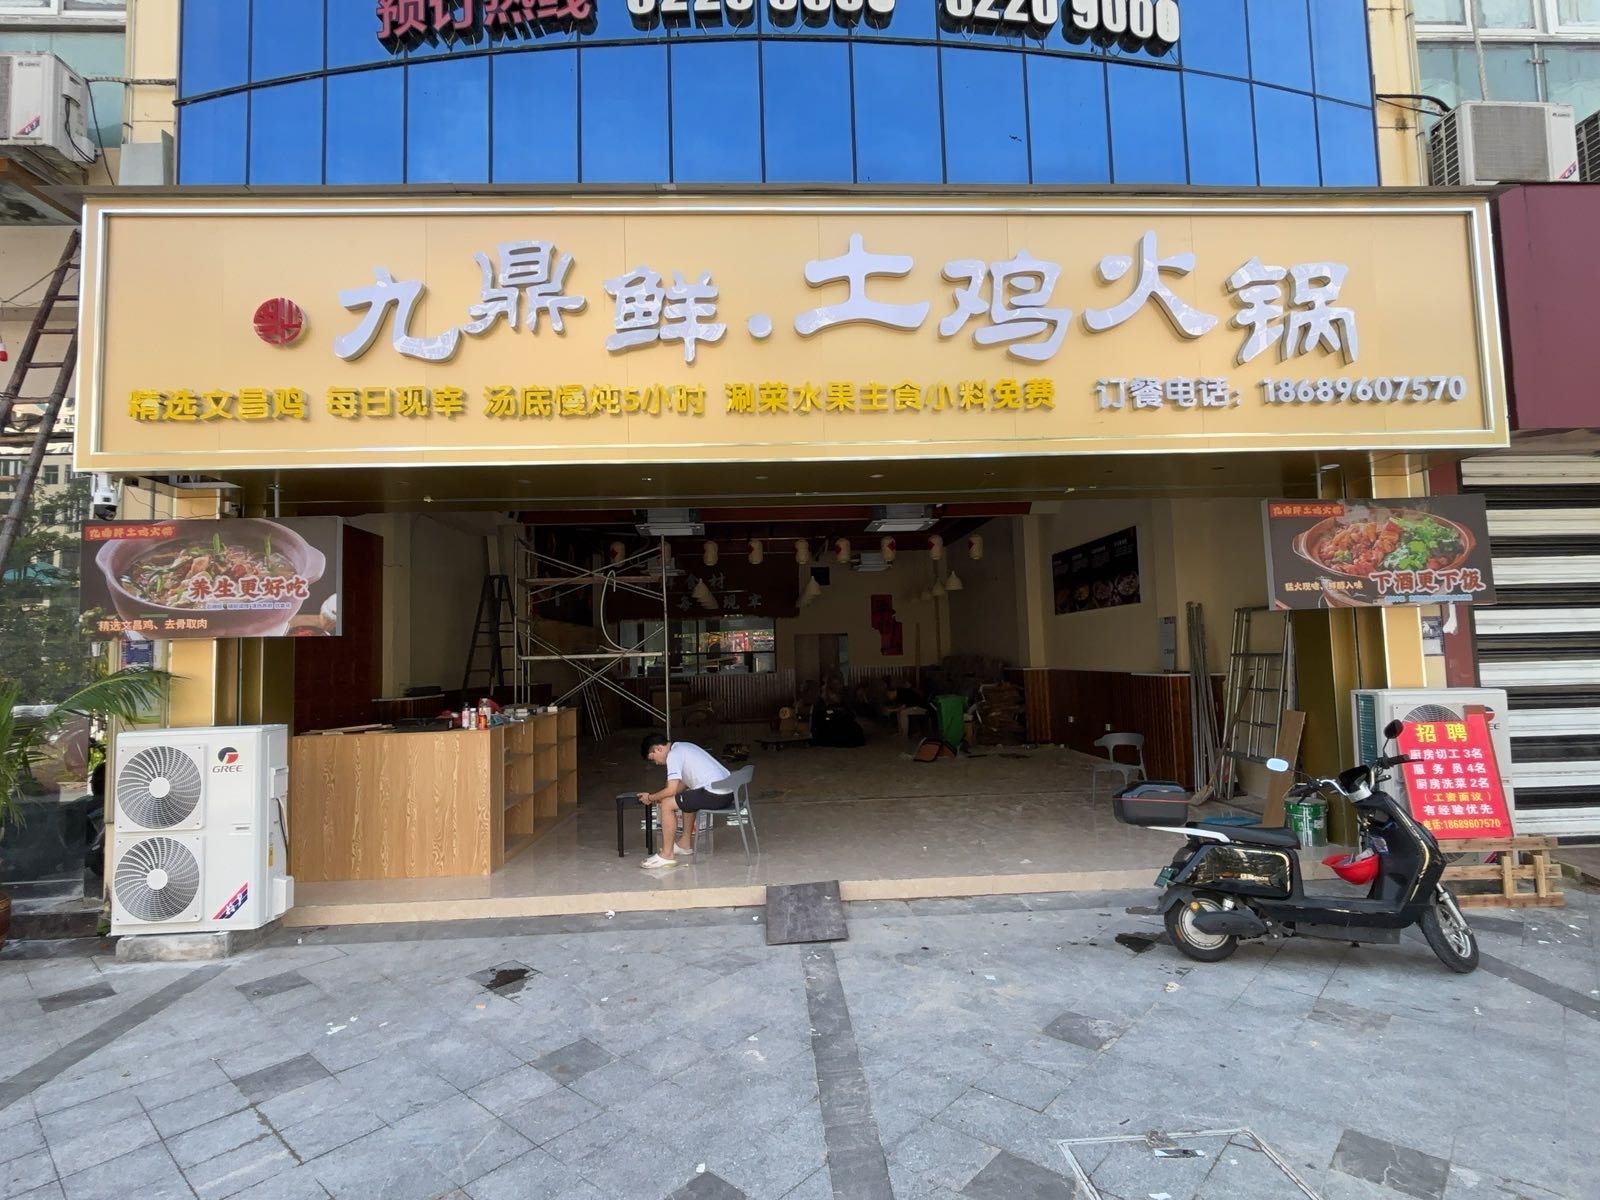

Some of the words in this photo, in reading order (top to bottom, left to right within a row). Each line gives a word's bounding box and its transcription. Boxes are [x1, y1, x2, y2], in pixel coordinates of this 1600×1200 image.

[128, 386, 306, 421] 精选文昌鸡
[326, 384, 466, 418] 每日现宰
[482, 383, 706, 418] 汤底慢炖5小时
[724, 378, 1057, 414] 涮菜水果主食小料免费
[1262, 374, 1467, 404] 18689607570
[1369, 568, 1486, 595] 下酒更下饭
[187, 575, 309, 602] 养生更好吃
[1415, 723, 1468, 743] 招聘
[1409, 749, 1460, 760] 厨房切工
[1463, 748, 1483, 759] 3名
[212, 764, 243, 773] GREE
[1412, 763, 1463, 775] 服务员
[1466, 763, 1486, 774] 4名
[1415, 779, 1467, 789] 厨房洗菜
[1470, 778, 1490, 788] 2名
[1424, 804, 1494, 815] 有经验优先
